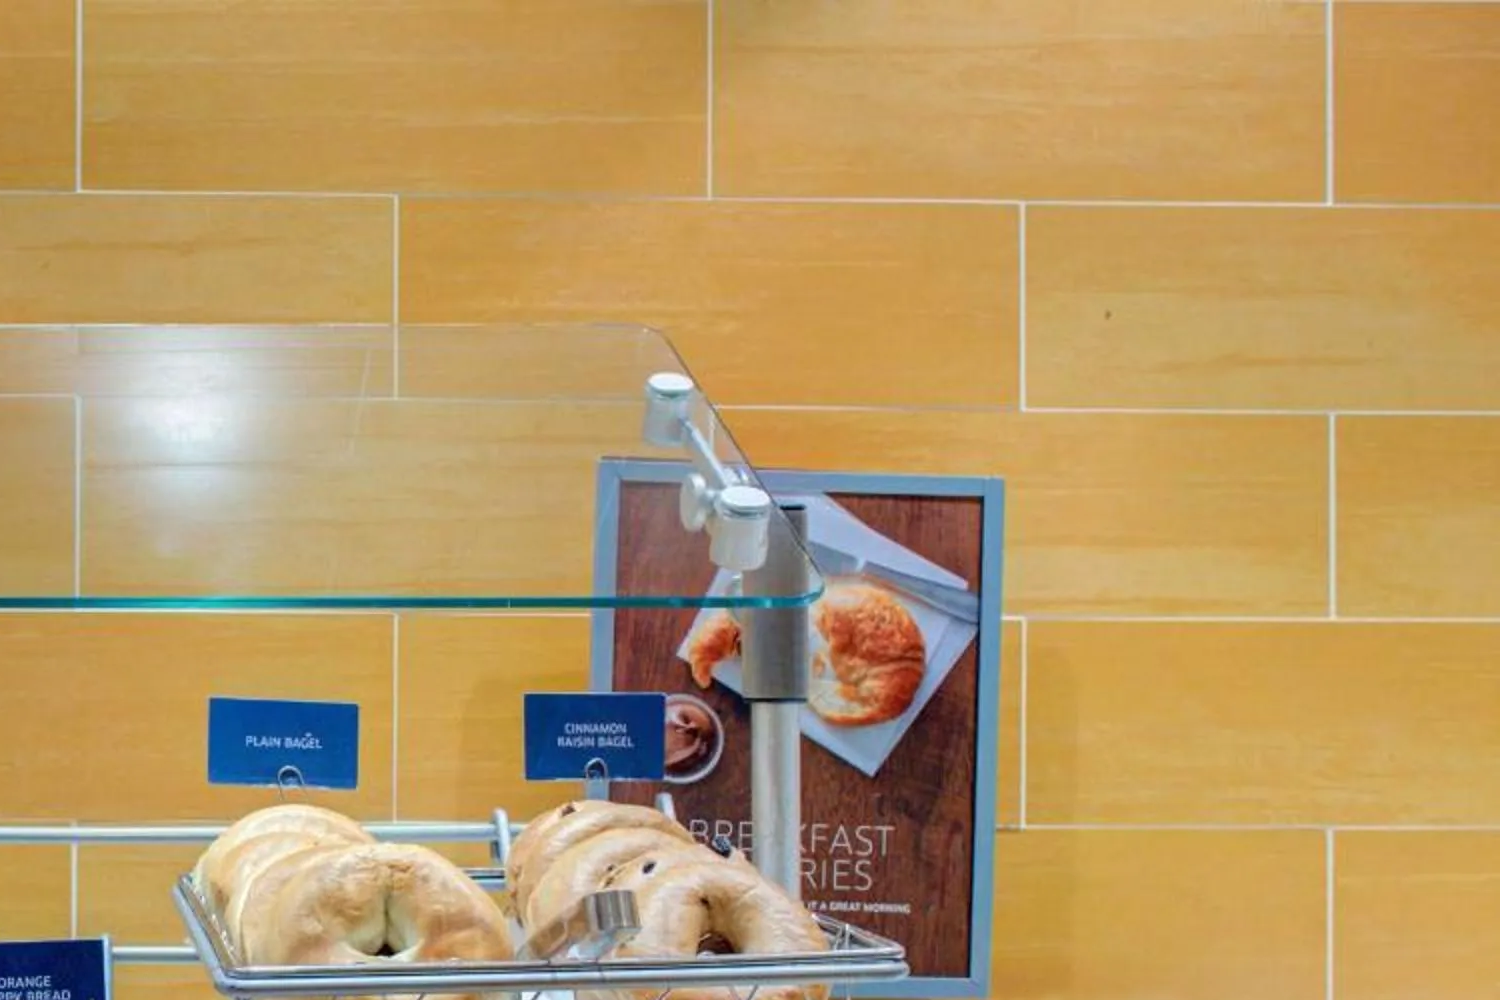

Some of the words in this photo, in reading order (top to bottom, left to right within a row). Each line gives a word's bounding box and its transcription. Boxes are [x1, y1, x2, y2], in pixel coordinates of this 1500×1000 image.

[564, 722, 627, 735] CINNAMON
[245, 735, 281, 748] PLAIN
[284, 737, 323, 750] BAGEL
[557, 736, 595, 748] RAISIN
[598, 736, 634, 748] BAGEL
[689, 819, 895, 857] BREFAST
[829, 901, 860, 912] GREAT
[863, 903, 911, 914] MORNING
